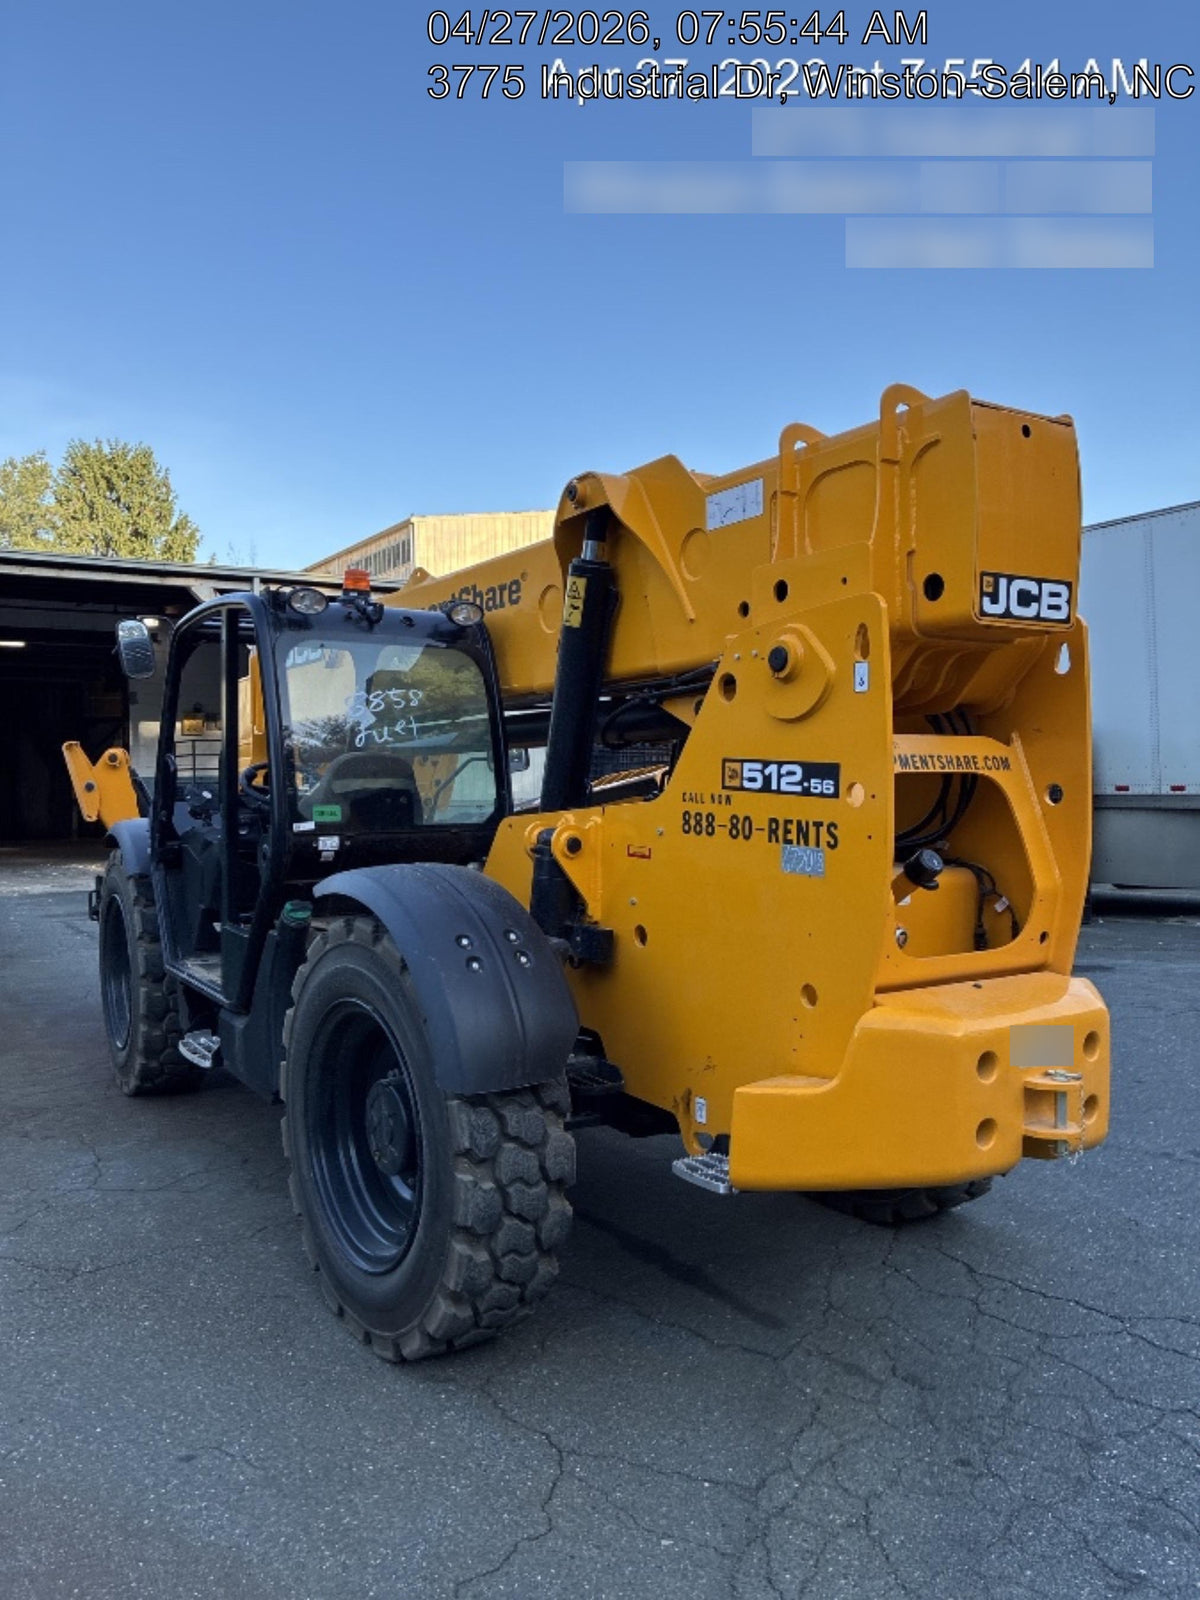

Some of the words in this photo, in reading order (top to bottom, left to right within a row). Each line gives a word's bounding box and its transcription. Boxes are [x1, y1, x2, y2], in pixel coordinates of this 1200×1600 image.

[982, 577, 1070, 619] JCB
[682, 791, 705, 805] CALL
[710, 793, 733, 806] NOW
[682, 810, 839, 850] 888-80-RENTS
